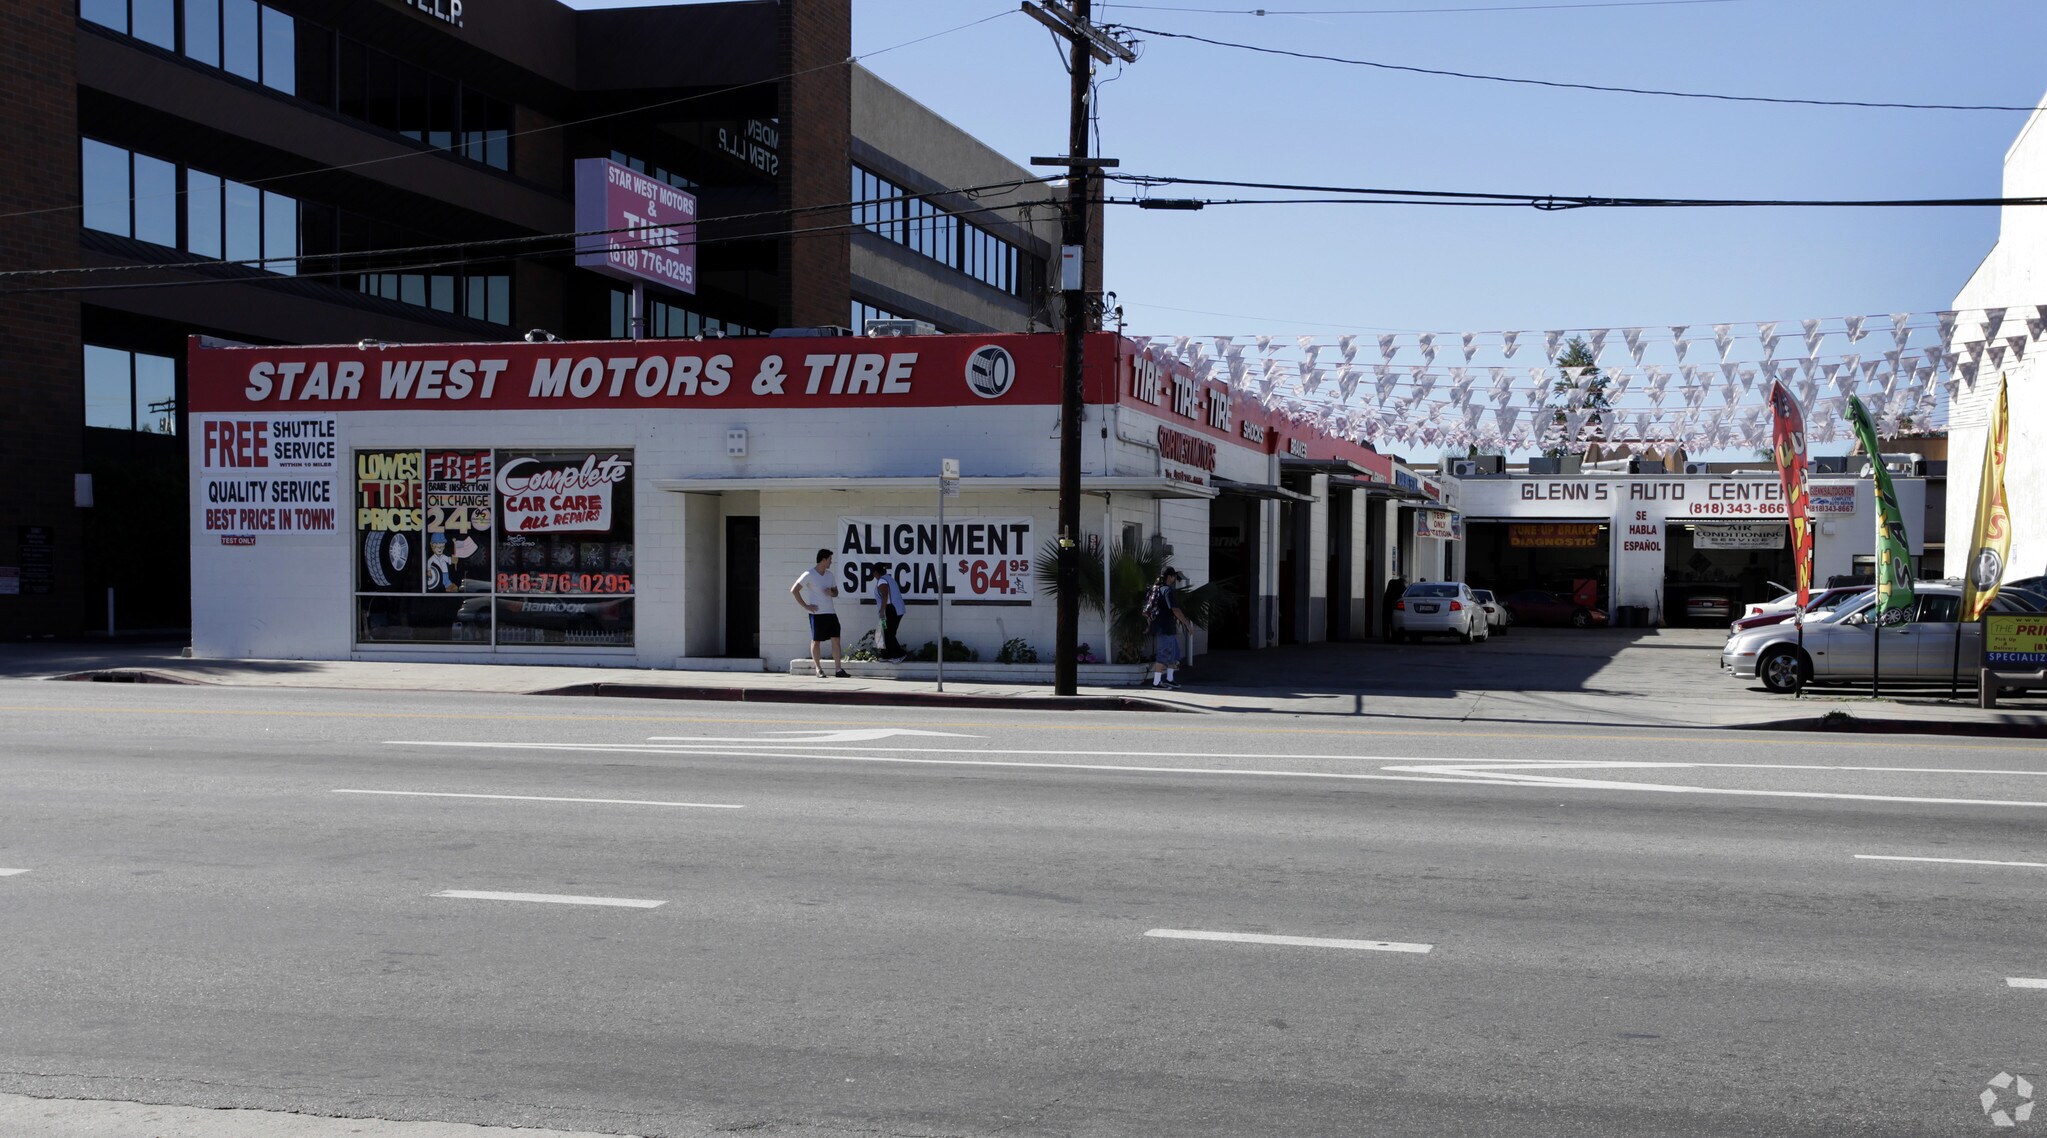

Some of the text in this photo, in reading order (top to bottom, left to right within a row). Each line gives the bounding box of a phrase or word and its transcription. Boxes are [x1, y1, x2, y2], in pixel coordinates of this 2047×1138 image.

[608, 166, 694, 216] STAR WEST MOTORS
[647, 200, 657, 218] &
[623, 211, 680, 255] TIRE
[609, 237, 693, 285] (818) 776-0295
[245, 352, 919, 402] STAR WEST MOTORS & TIRE
[1133, 356, 1232, 433] TIRE TIRE TIRE
[273, 420, 335, 438] SHUTTLE
[204, 420, 269, 468] FREE
[274, 441, 335, 459] SERVICE
[427, 452, 491, 483] FREE
[496, 454, 632, 497] Complete
[208, 480, 330, 504] QUALITY SERVICE
[358, 480, 422, 508] TIRE
[449, 482, 489, 492] INSPECTION
[1630, 483, 1685, 500] AUTO
[447, 495, 489, 506] CHANGE
[506, 495, 603, 512] CAR CARE
[1689, 502, 1724, 515] (818)
[206, 508, 335, 530] BEST PRICE IN TOWN!
[358, 508, 422, 532] PRICES
[427, 507, 471, 534] 24
[520, 510, 600, 530] ALL REPAIRS
[1434, 511, 1446, 519] TEST
[1434, 520, 1447, 528] ONLY
[1636, 511, 1647, 520] SE
[842, 524, 1030, 555] ALIGNMENT
[1629, 524, 1657, 535] HABLA
[1511, 538, 1596, 546] DIAGNOSTIC
[1624, 539, 1661, 551] ESPAÑOL
[497, 573, 631, 593] 818-776-0295
[843, 561, 956, 594] SPCIAL
[1995, 624, 2014, 632] THE
